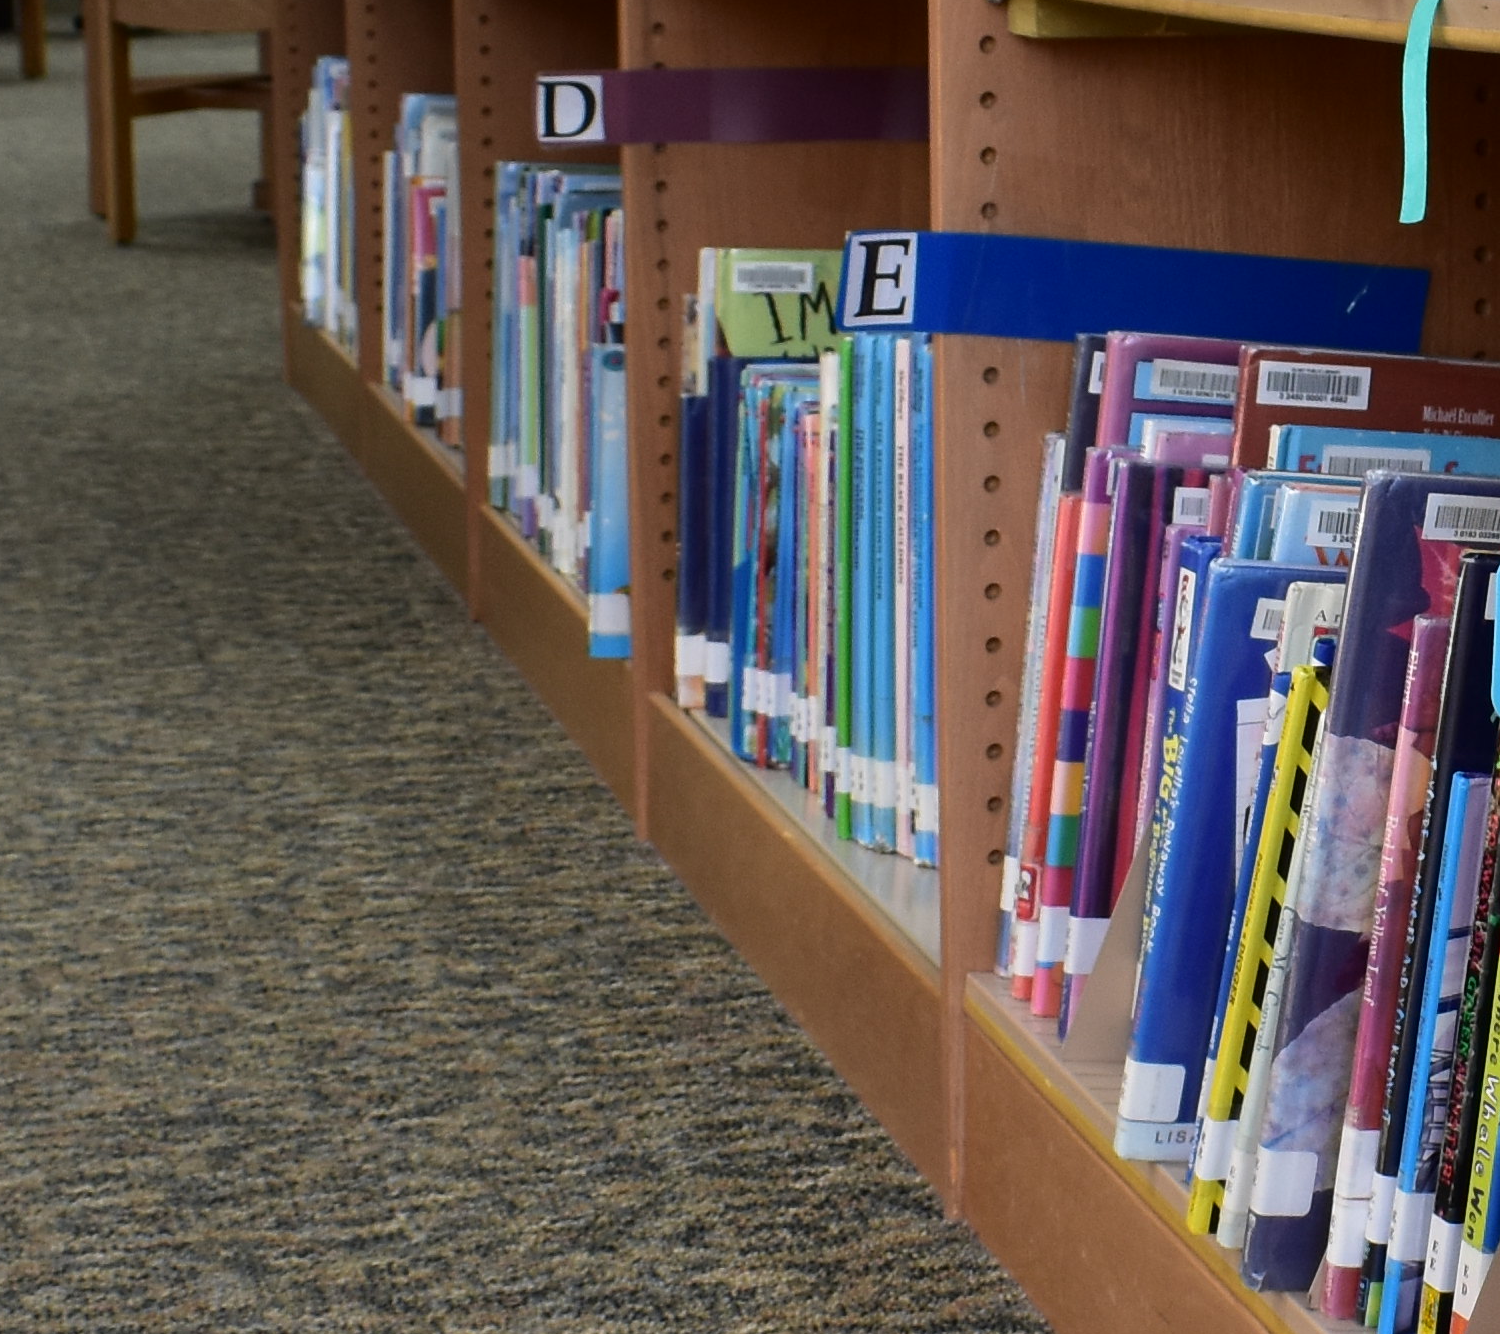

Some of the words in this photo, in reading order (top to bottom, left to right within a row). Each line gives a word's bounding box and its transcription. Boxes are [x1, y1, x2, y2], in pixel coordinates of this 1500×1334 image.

[540, 80, 596, 138] D
[854, 238, 911, 318] E
[1382, 815, 1399, 851] Red
[1367, 905, 1386, 960] Yellow
[1362, 964, 1379, 1007] Leaf
[1464, 1187, 1484, 1242] Wen
